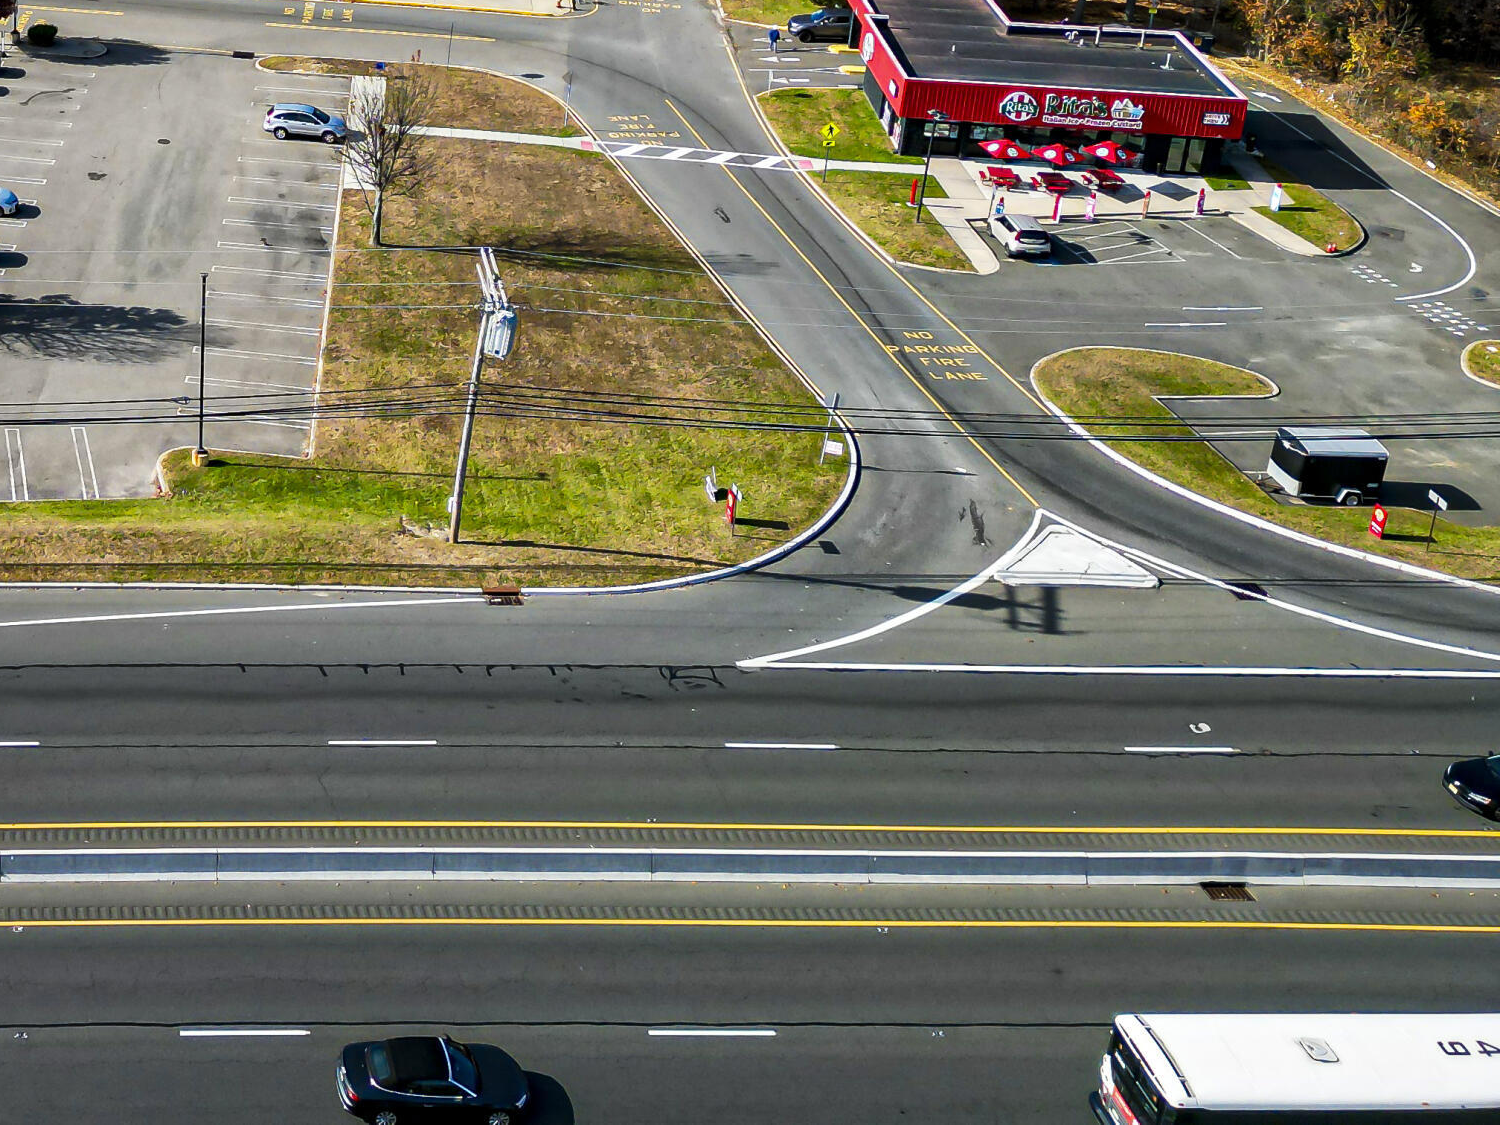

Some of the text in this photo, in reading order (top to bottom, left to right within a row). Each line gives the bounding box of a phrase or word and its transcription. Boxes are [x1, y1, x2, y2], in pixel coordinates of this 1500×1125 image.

[1005, 100, 1036, 114] Rita's
[1044, 93, 1108, 117] Rita's
[1043, 115, 1068, 124] Italian
[902, 331, 934, 340] NO
[884, 345, 979, 354] PARKING
[919, 357, 971, 366] FIRE
[929, 372, 988, 380] LANE
